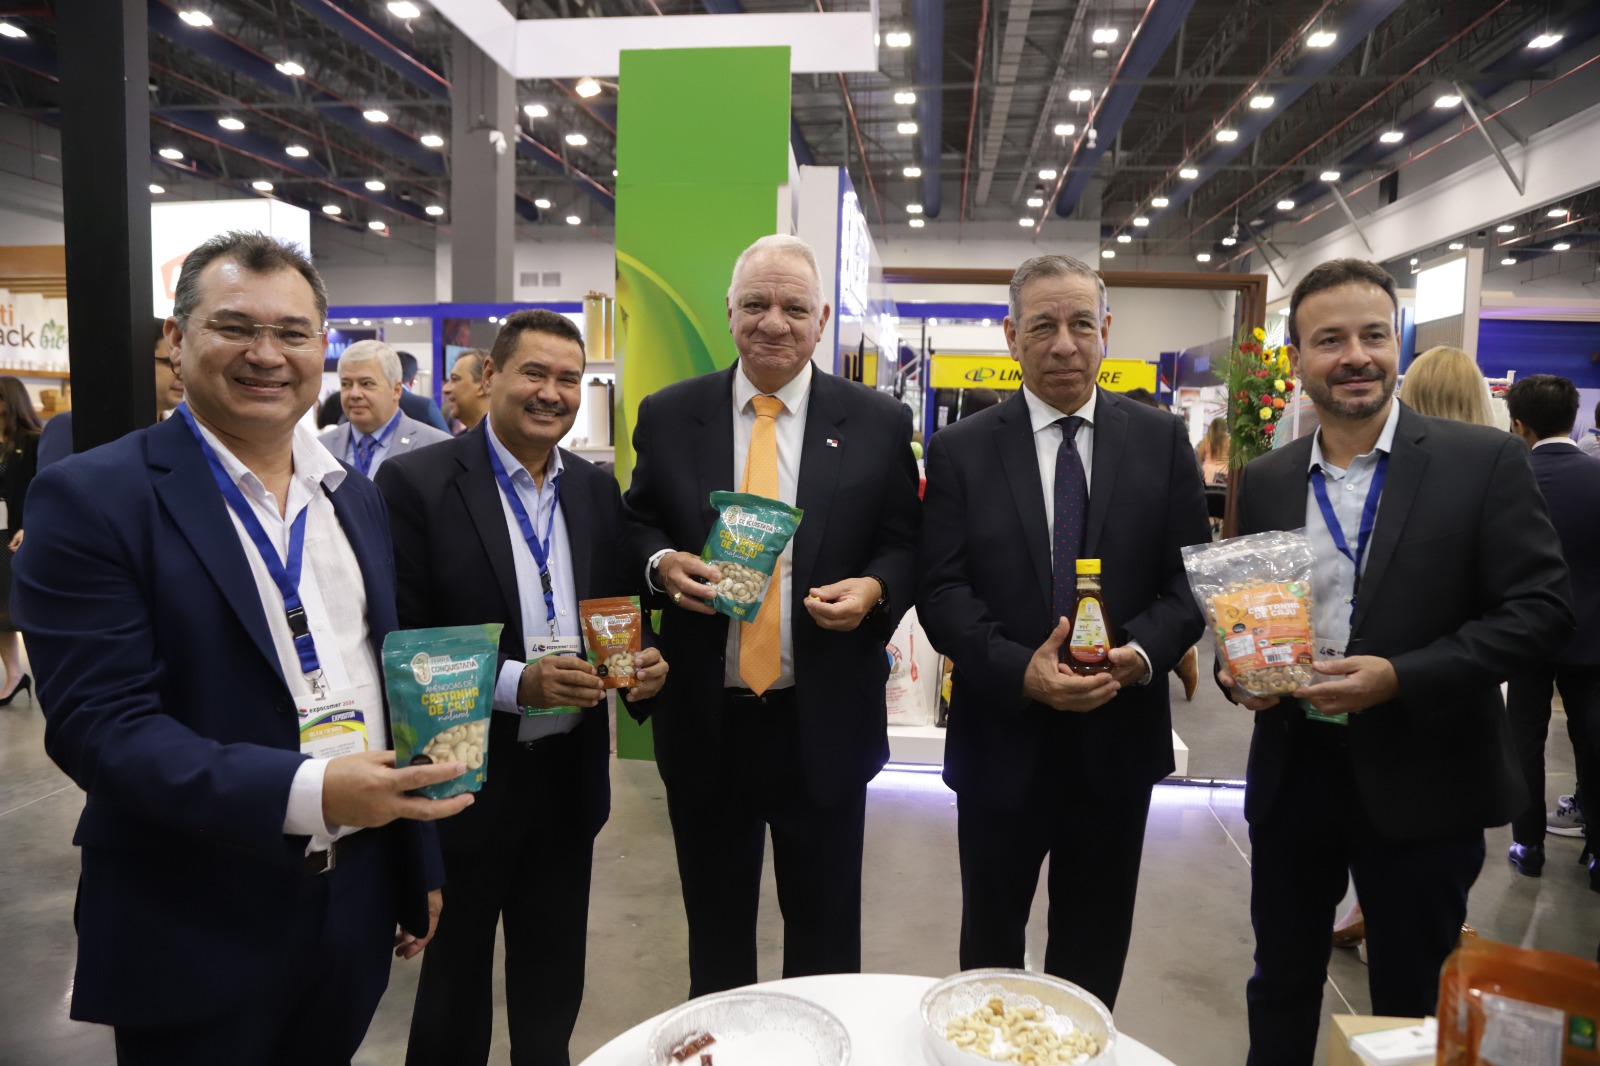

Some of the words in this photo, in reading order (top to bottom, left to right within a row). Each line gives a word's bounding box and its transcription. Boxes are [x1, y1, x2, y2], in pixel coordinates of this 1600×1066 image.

[720, 539, 733, 550] DE
[733, 543, 758, 559] CAJU
[1247, 602, 1301, 616] CASTANHA
[1270, 608, 1297, 617] CAJU
[596, 632, 631, 641] CASANHA
[421, 686, 480, 706] CASTANHA
[309, 702, 342, 714] expocomer
[342, 699, 355, 707] 2024
[428, 703, 445, 716] DE
[447, 698, 476, 712] CAJU
